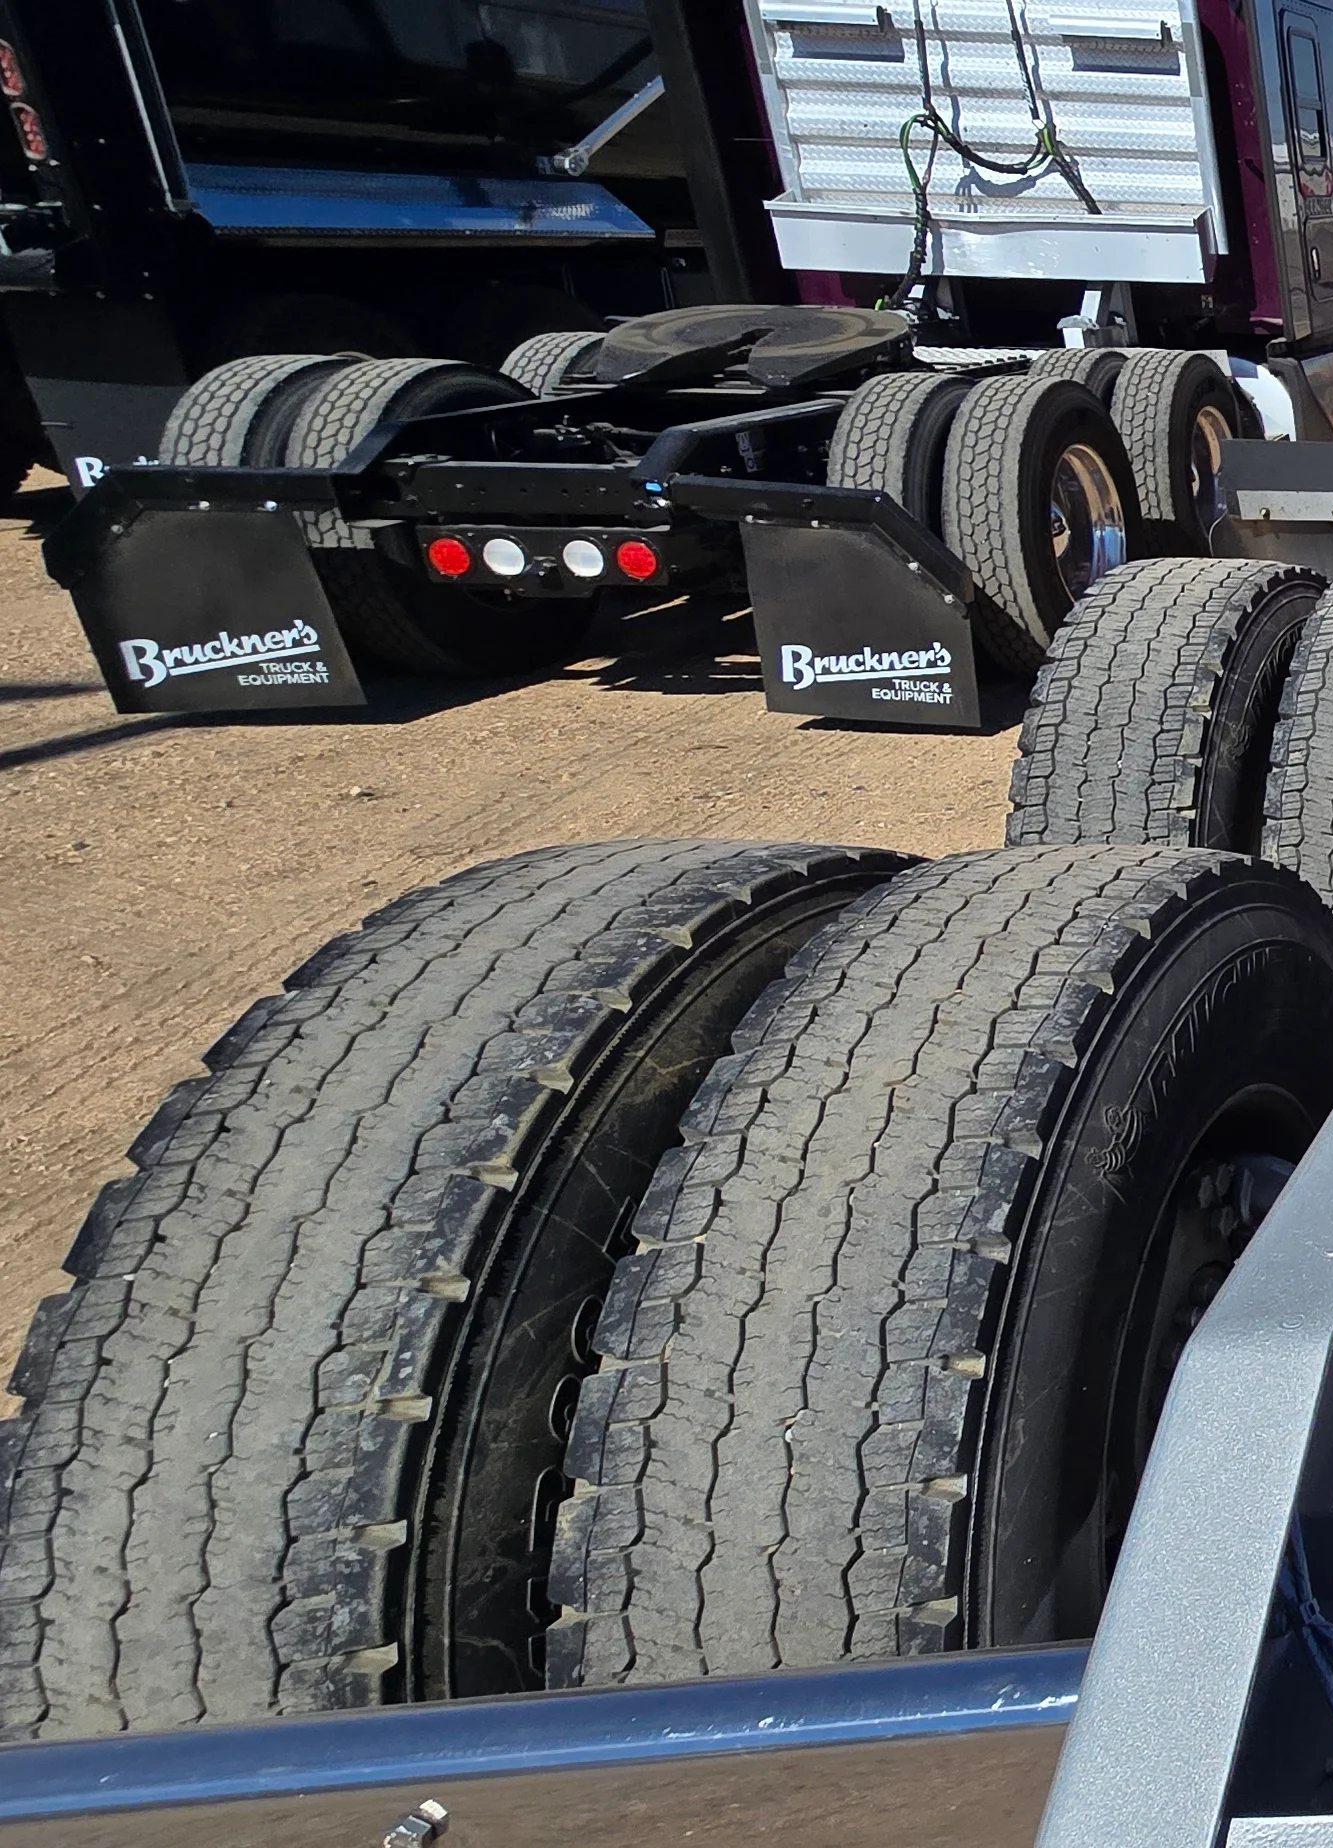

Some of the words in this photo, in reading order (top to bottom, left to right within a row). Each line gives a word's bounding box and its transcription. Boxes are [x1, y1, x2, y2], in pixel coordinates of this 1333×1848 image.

[119, 619, 320, 688] Bruckner's
[260, 661, 312, 674] TRUCK
[315, 661, 327, 673] &
[781, 641, 951, 690] Bruckner's
[238, 672, 330, 686] EQUIPMENT
[892, 679, 940, 692] TRUCK
[942, 683, 952, 694] &
[871, 688, 953, 704] EQUIPMENT
